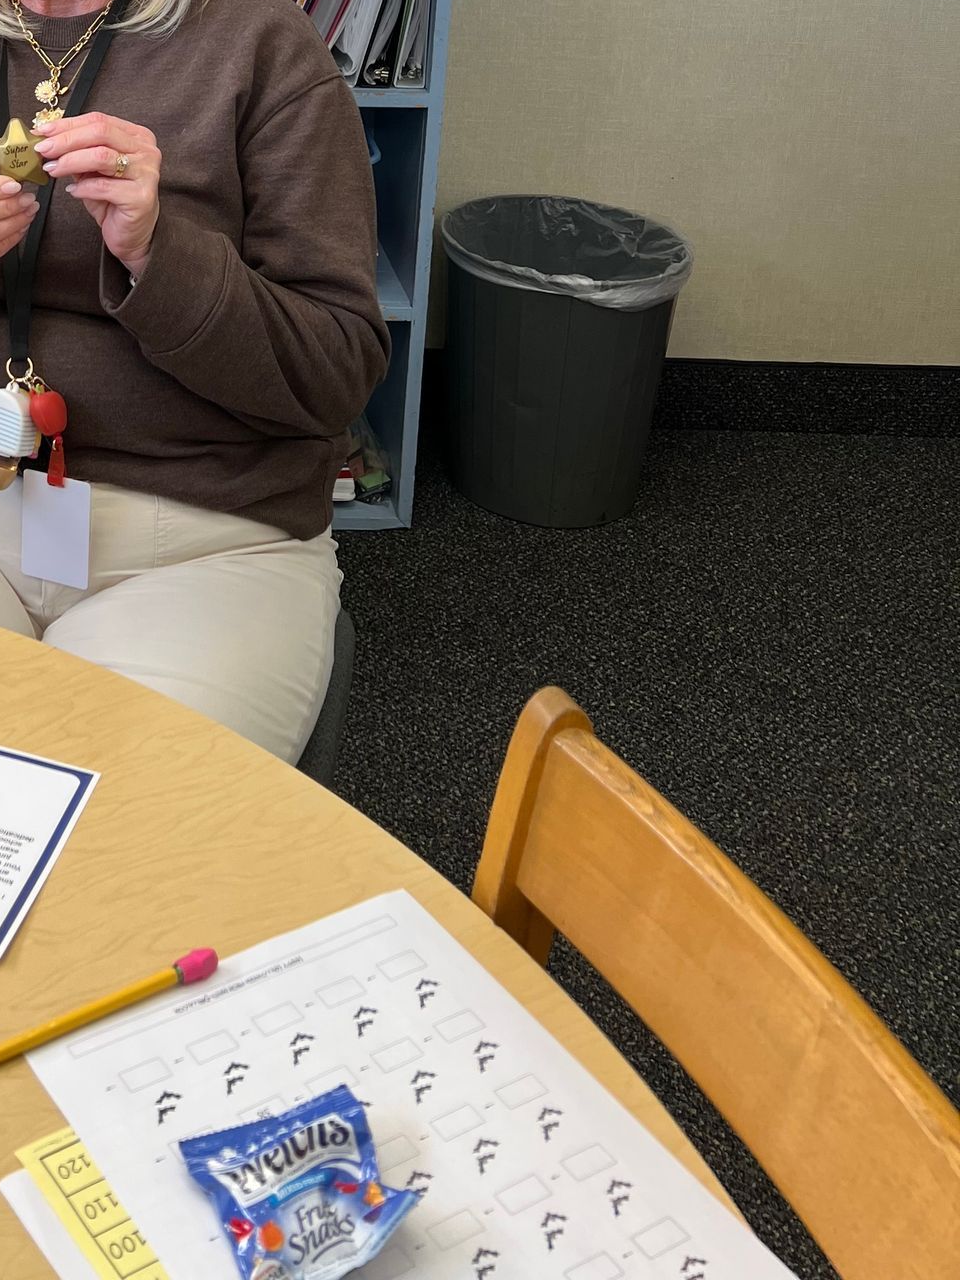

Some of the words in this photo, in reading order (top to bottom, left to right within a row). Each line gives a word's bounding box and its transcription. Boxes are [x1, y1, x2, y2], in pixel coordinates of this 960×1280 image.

[3, 144, 30, 159] Super
[9, 158, 29, 169] Star
[57, 1154, 91, 1180] 120
[84, 1192, 119, 1220] 110
[109, 1230, 147, 1260] 100
